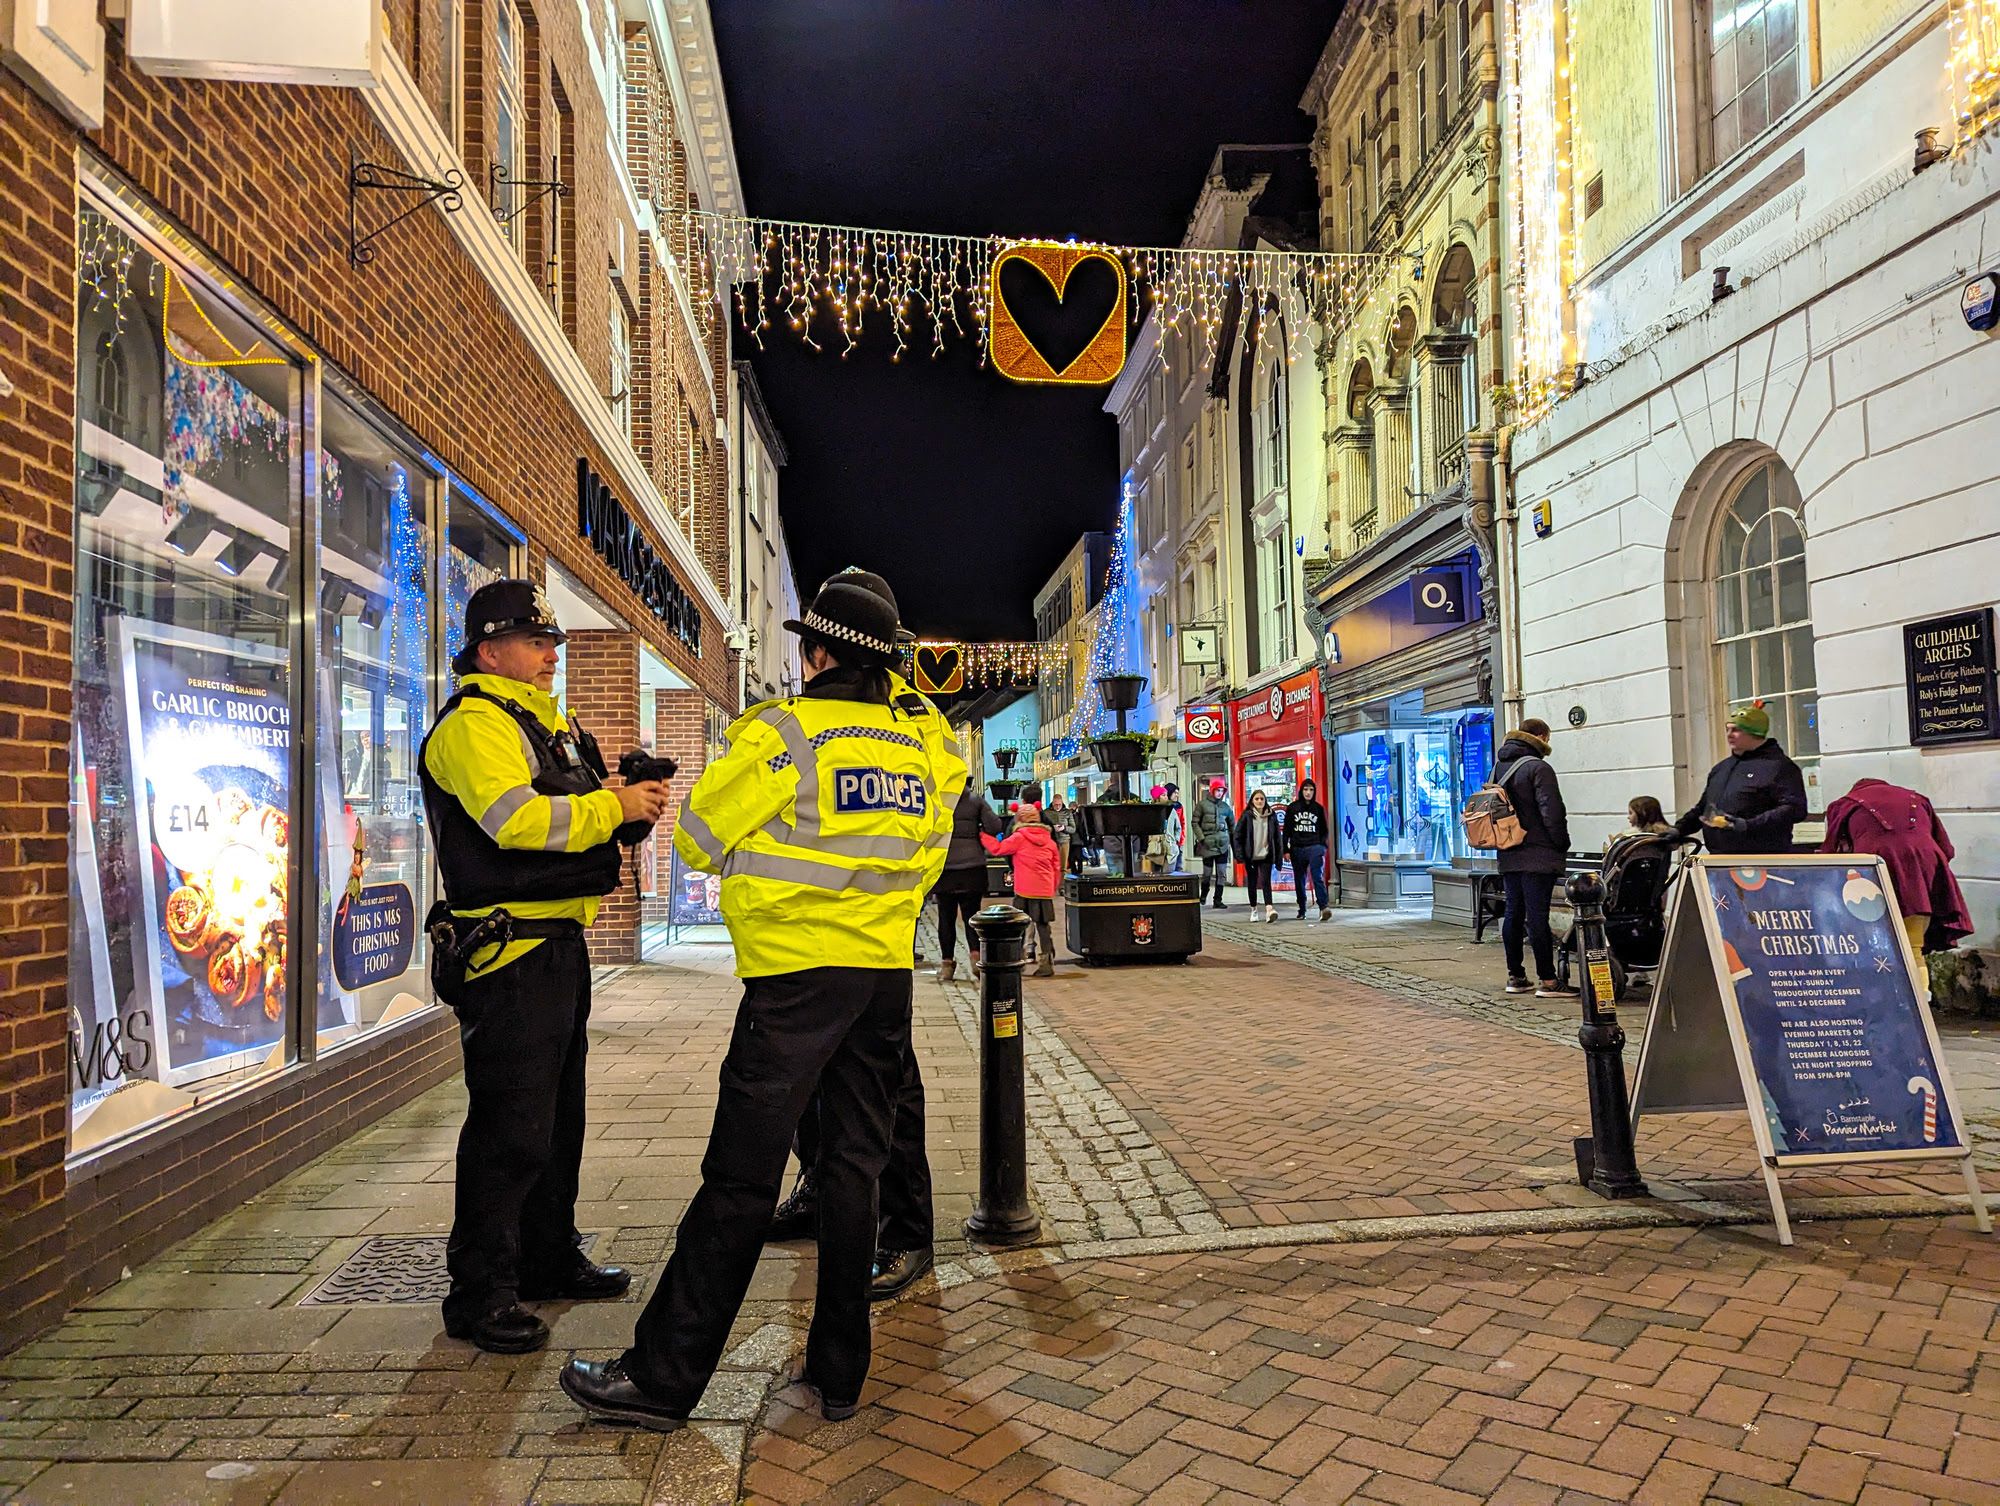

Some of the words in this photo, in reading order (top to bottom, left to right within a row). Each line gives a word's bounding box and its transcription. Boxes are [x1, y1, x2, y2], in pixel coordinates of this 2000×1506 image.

[1915, 624, 1981, 649] GUILDHALL
[1924, 642, 1972, 664] ARCHES
[1960, 665, 1985, 677] Kitchen
[188, 678, 220, 691] PERFECT
[221, 682, 235, 692] FOR
[235, 686, 267, 697] SHARING
[1939, 686, 1959, 698] Fudge
[1960, 684, 1983, 695] Pantry
[152, 690, 221, 718] GARLIC
[1237, 700, 1268, 722] ENTERTAINMENT
[1285, 685, 1312, 706] EXCHANGE
[1920, 708, 1933, 718] The
[1933, 705, 1959, 717] Pannier
[1960, 702, 1985, 713] Market
[840, 773, 925, 809] POLICE
[169, 804, 210, 832] £14
[1093, 886, 1134, 896] Barnstaple
[1135, 885, 1157, 893] Town
[1158, 883, 1187, 892] Council
[351, 912, 371, 933] THIS
[373, 911, 382, 929] IS
[384, 908, 401, 926] M&S
[1752, 909, 1814, 930] MERRY
[352, 928, 400, 956] CHRISTMAS
[1760, 934, 1860, 956] CHRISTMAS
[364, 952, 389, 975] FOOD
[1789, 969, 1824, 977] 9AM-4PM
[1771, 979, 1834, 987] MONDAY-SUNDAY
[1824, 988, 1862, 996] DECEMBER
[1794, 1020, 1808, 1028] ARE
[1817, 1029, 1852, 1037] MARKETS
[67, 1009, 152, 1095] M&S
[1789, 1051, 1828, 1059] DECEMBER
[1829, 1049, 1871, 1057] ALONGSIDE
[1792, 1062, 1810, 1070] LATE
[1836, 1060, 1873, 1068] SHOPPING
[1817, 1071, 1852, 1079] 5PM-8PM
[1840, 1113, 1877, 1123] Barnstaple
[1822, 1123, 1858, 1136] Pannier
[1859, 1120, 1898, 1136] Market
